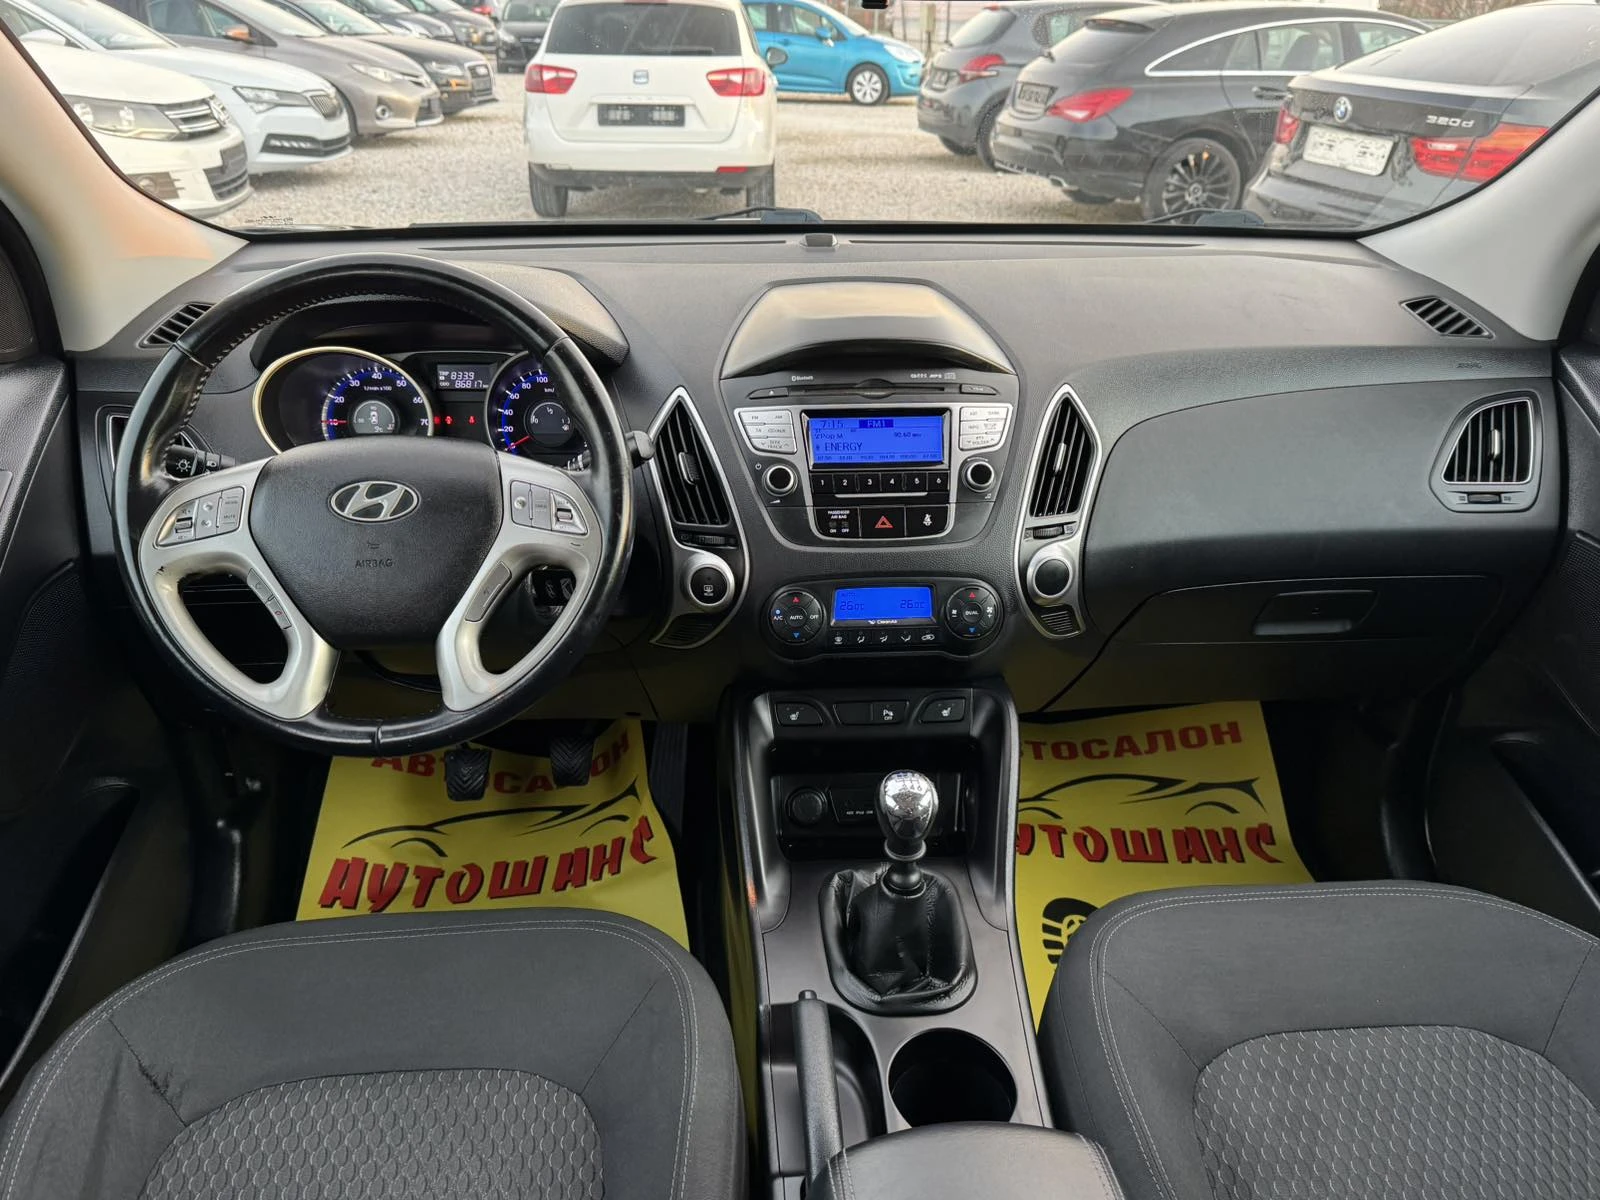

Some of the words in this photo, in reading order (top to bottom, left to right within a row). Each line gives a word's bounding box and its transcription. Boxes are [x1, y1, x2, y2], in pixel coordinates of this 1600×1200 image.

[371, 372, 382, 380] 40
[420, 418, 429, 426] 70
[824, 441, 863, 452] ENERGY
[354, 558, 393, 569] AIRBAG
[1020, 721, 1242, 761] ТОСАЛОН
[371, 731, 630, 795] АВСАОН
[318, 815, 657, 912] АУТОШАНС
